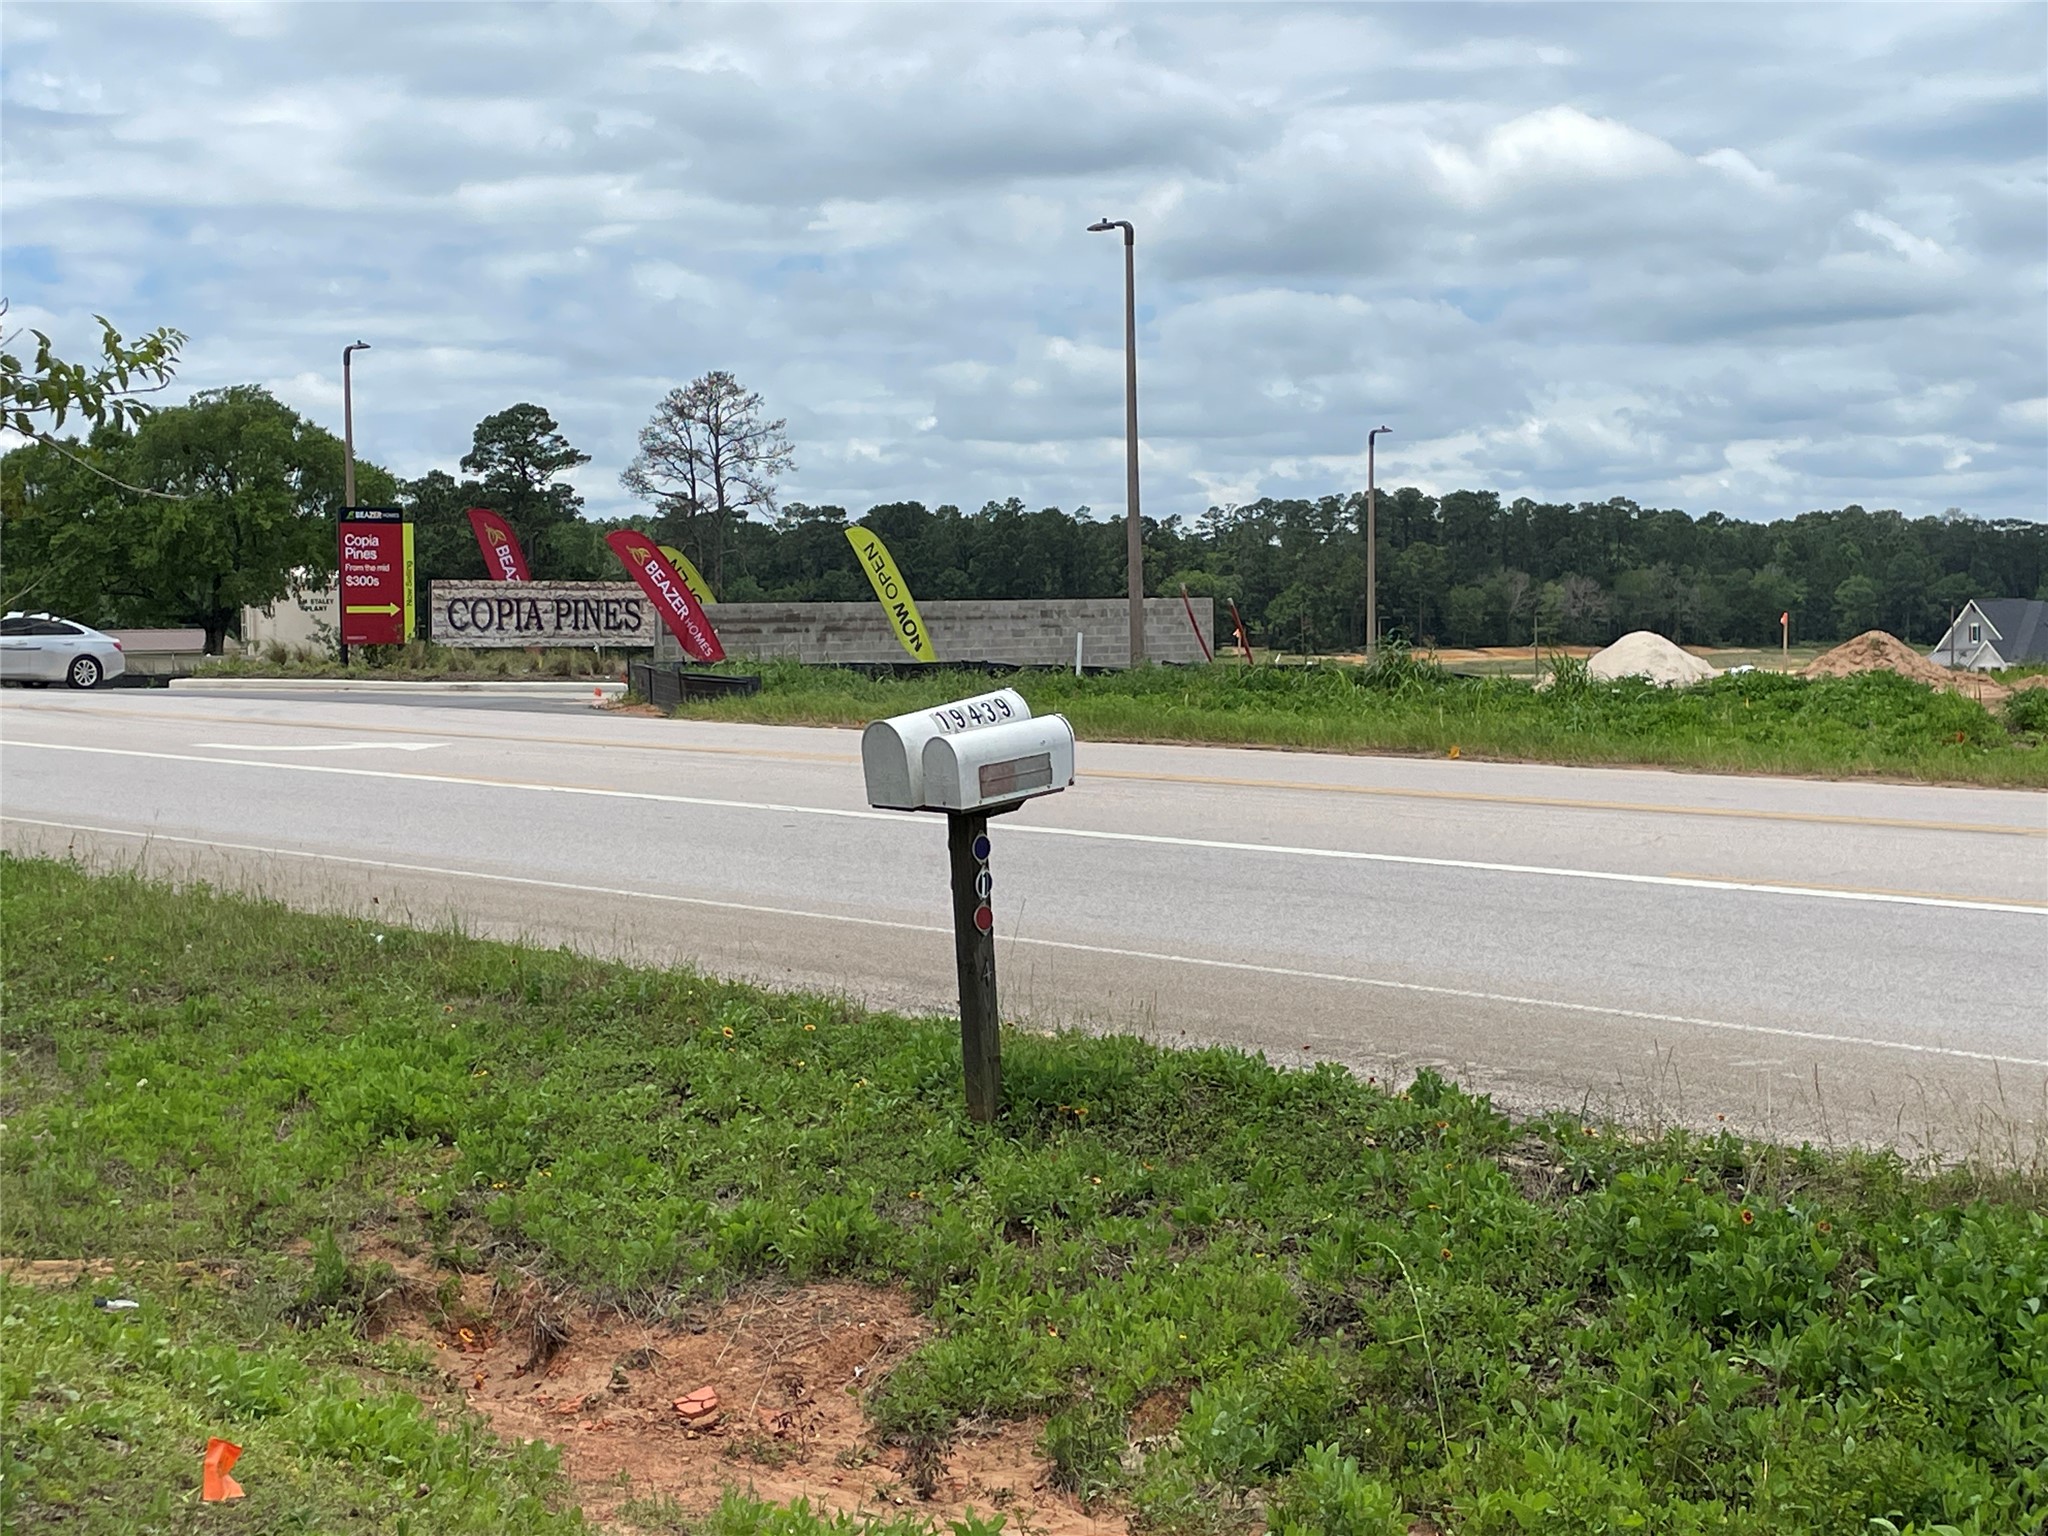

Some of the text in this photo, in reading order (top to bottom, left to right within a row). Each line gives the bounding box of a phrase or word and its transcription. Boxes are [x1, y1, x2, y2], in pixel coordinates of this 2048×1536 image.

[355, 510, 382, 519] BEAZER
[344, 533, 380, 548] Copia
[345, 547, 378, 560] Pines
[344, 562, 390, 572] From the mid
[346, 575, 379, 587] $300s
[863, 541, 923, 653] NOW OPEN
[447, 598, 642, 632] COPIA PINES
[644, 559, 690, 621] BEAZER
[684, 616, 714, 657] HOMES
[934, 698, 1012, 731] 19439
